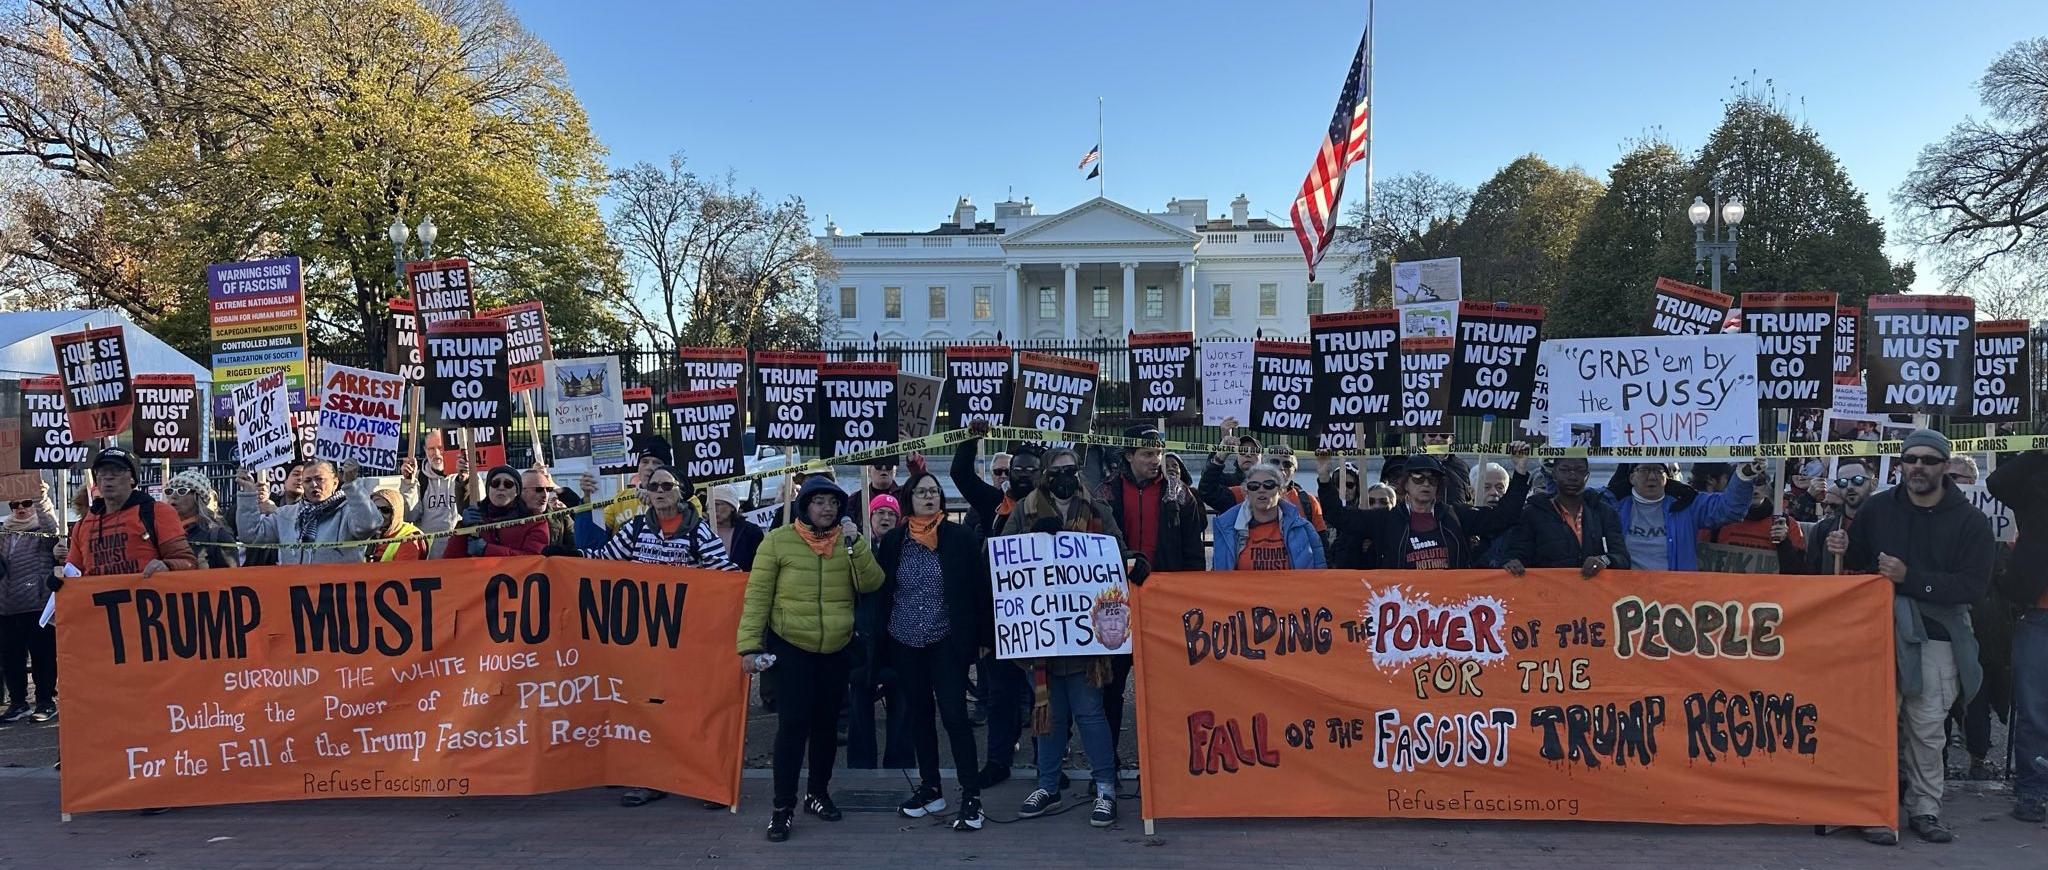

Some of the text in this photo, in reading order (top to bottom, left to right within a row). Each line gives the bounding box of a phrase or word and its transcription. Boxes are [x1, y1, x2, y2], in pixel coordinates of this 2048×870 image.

[217, 264, 292, 282] WARNING SIGNS
[415, 269, 466, 293] ¡QUE SE
[223, 277, 287, 295] OF FASCISM
[215, 295, 295, 310] EXTREME NATIONALISM
[417, 289, 470, 310] LARGUE
[1655, 293, 1723, 325] TRUMP
[214, 309, 298, 324] DISDAIN FOR HUMAN RIGHTS
[521, 311, 540, 327] SE
[1315, 311, 1394, 323] RefuseFascism.org
[1746, 313, 1830, 333] TRUMP
[1874, 315, 1969, 336] TRUMP
[216, 323, 298, 337] SCAPEGOATING MINORITIES
[61, 337, 120, 366] ¡QUE SE
[222, 336, 292, 350] CONTROLLED MEDIA
[428, 338, 504, 357] TRUMP
[1315, 330, 1396, 353] TRUMP
[1757, 336, 1821, 355] MUST
[1882, 338, 1959, 359] MUST
[217, 354, 263, 365] MILITARIZATION
[272, 350, 298, 360] SOCIETY
[1132, 347, 1191, 364] TRUMP
[1324, 352, 1389, 373] MUST
[1654, 346, 1693, 375] 'em
[1704, 346, 1737, 383] by
[64, 359, 124, 386] LARGUE
[226, 365, 291, 378] RIGGED ELECTIONS
[436, 359, 497, 378] MUST
[512, 369, 537, 385] YA!
[1138, 363, 1185, 380] MUST
[1770, 358, 1804, 377] GO
[1900, 361, 1940, 382] GO
[234, 382, 256, 407] TAKE
[256, 370, 284, 396] MONEY
[326, 371, 404, 401] ARREST
[451, 380, 483, 399] GO
[822, 380, 894, 398] TRUMP
[903, 382, 932, 401] IS A
[1224, 379, 1245, 390] CALL
[1340, 374, 1374, 394] GO
[1758, 380, 1820, 400] NOW!
[70, 382, 124, 407] TRUMP
[135, 388, 194, 404] TRUMP
[1578, 390, 1613, 414] the
[1885, 384, 1957, 406] NOW!
[141, 405, 189, 420] MUST
[238, 402, 258, 426] OUT
[260, 391, 276, 416] OF
[325, 394, 401, 421] SEXUAL
[440, 401, 498, 421] NOW!
[555, 406, 569, 416] NO
[672, 404, 736, 424] TRUMP
[830, 400, 887, 418] MUST
[1329, 394, 1390, 416] NOW!
[91, 410, 117, 431] YA!
[153, 421, 178, 436] GO
[250, 414, 273, 437] OUR
[320, 410, 400, 438] PREDATORS
[1624, 412, 1708, 447] tRUMP
[343, 431, 376, 447] NOT
[681, 423, 731, 442] MUST
[144, 437, 189, 452] NOW!
[315, 439, 397, 469] PROTESTERS
[1449, 443, 1503, 455] CRIME SCENE
[1729, 443, 1854, 457] CRIME SCENE DO NOT CROSS
[1955, 439, 2008, 451] NOT CROSS
[992, 535, 1107, 567] HELL ISN'T
[996, 563, 1123, 593] HOT ENOUGH
[995, 594, 1093, 619] FOR CHILD
[92, 573, 688, 665] TRUMP MUST GO NOW
[997, 614, 1094, 656] RAPISTS
[1182, 595, 1784, 666] BUILDING THE POWER OF THE PEOPLE
[224, 667, 319, 691] SURROUND
[335, 666, 375, 689] THE
[391, 656, 466, 684] WHITE
[480, 651, 540, 672] HOUSE
[1411, 658, 1591, 700] FOR THE
[166, 675, 629, 733] Building the Power of the PEOPLE
[1186, 688, 1818, 777] FALL OF THE FASCIST TRUMP REGIME
[126, 719, 652, 780] For the Fall of the Trump Fascist Regime
[304, 770, 470, 795] RefuseFascism.org
[1388, 788, 1579, 816] RefuseFascism.org
